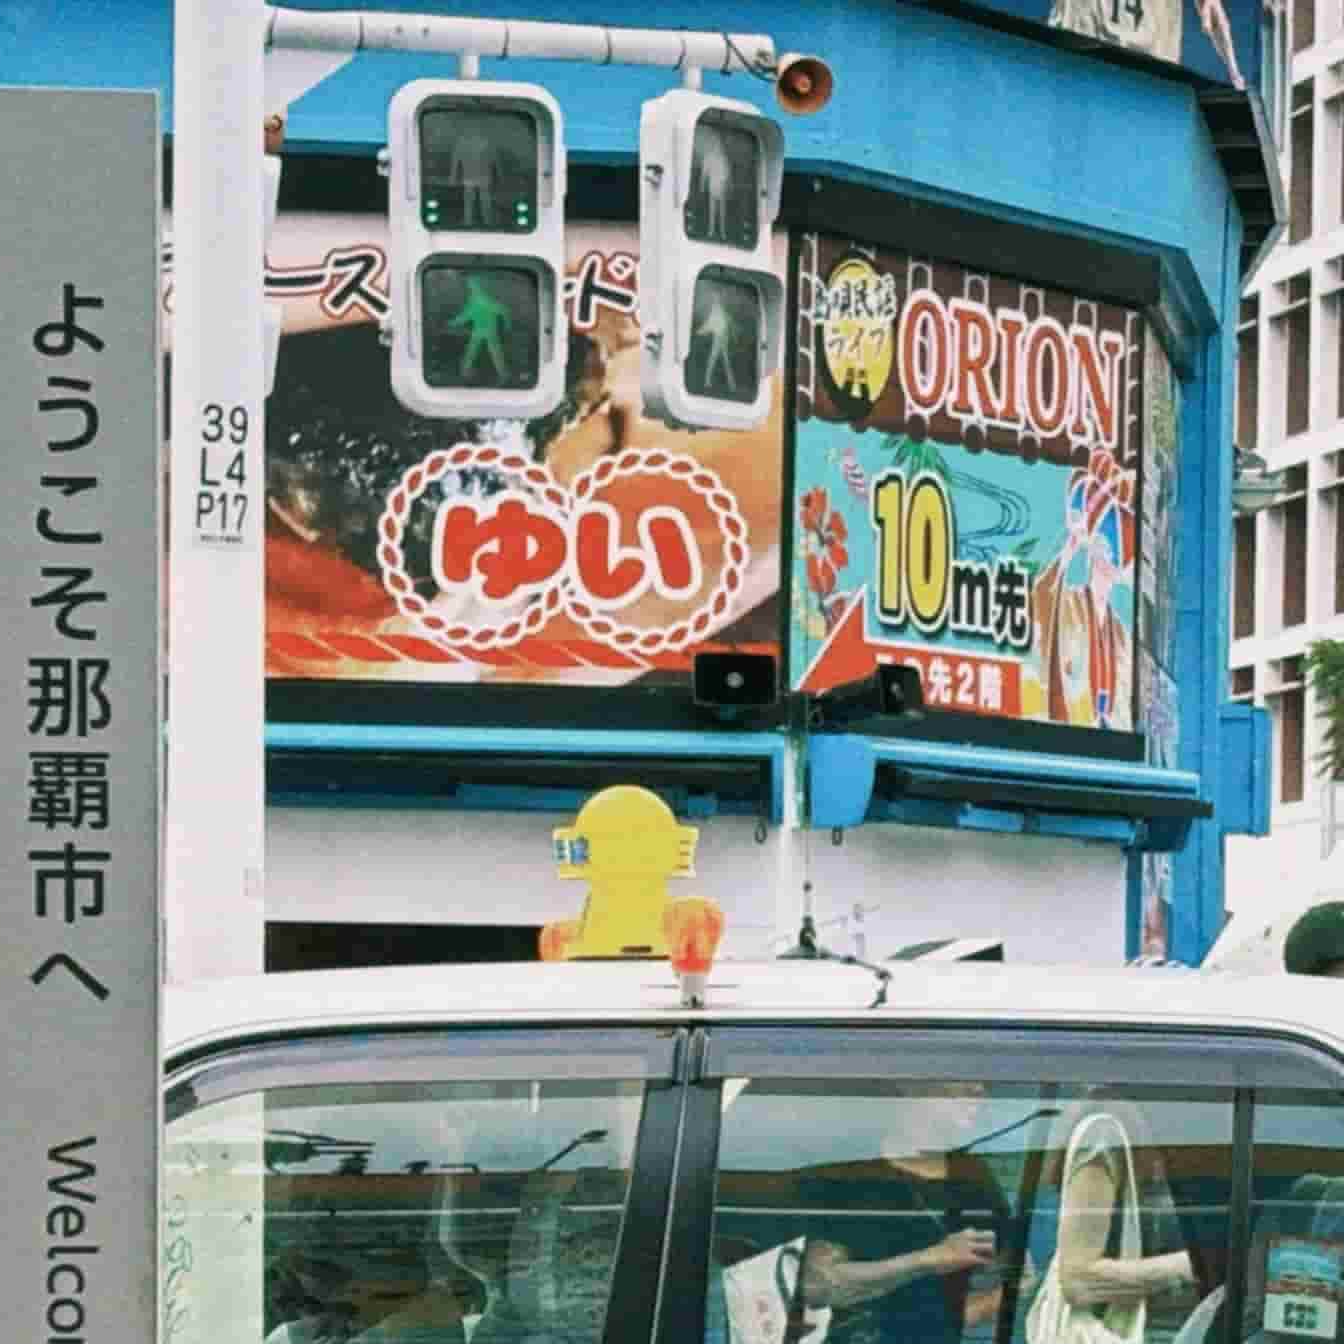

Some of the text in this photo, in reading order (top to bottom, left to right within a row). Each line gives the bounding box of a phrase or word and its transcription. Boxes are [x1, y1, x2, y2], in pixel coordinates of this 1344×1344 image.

[899, 288, 1125, 447] ORION
[201, 403, 248, 444] 39
[201, 447, 246, 488] L4
[196, 491, 249, 532] P17
[441, 499, 694, 601] ゆい
[28, 282, 112, 1001] ようこそ那覇市へ
